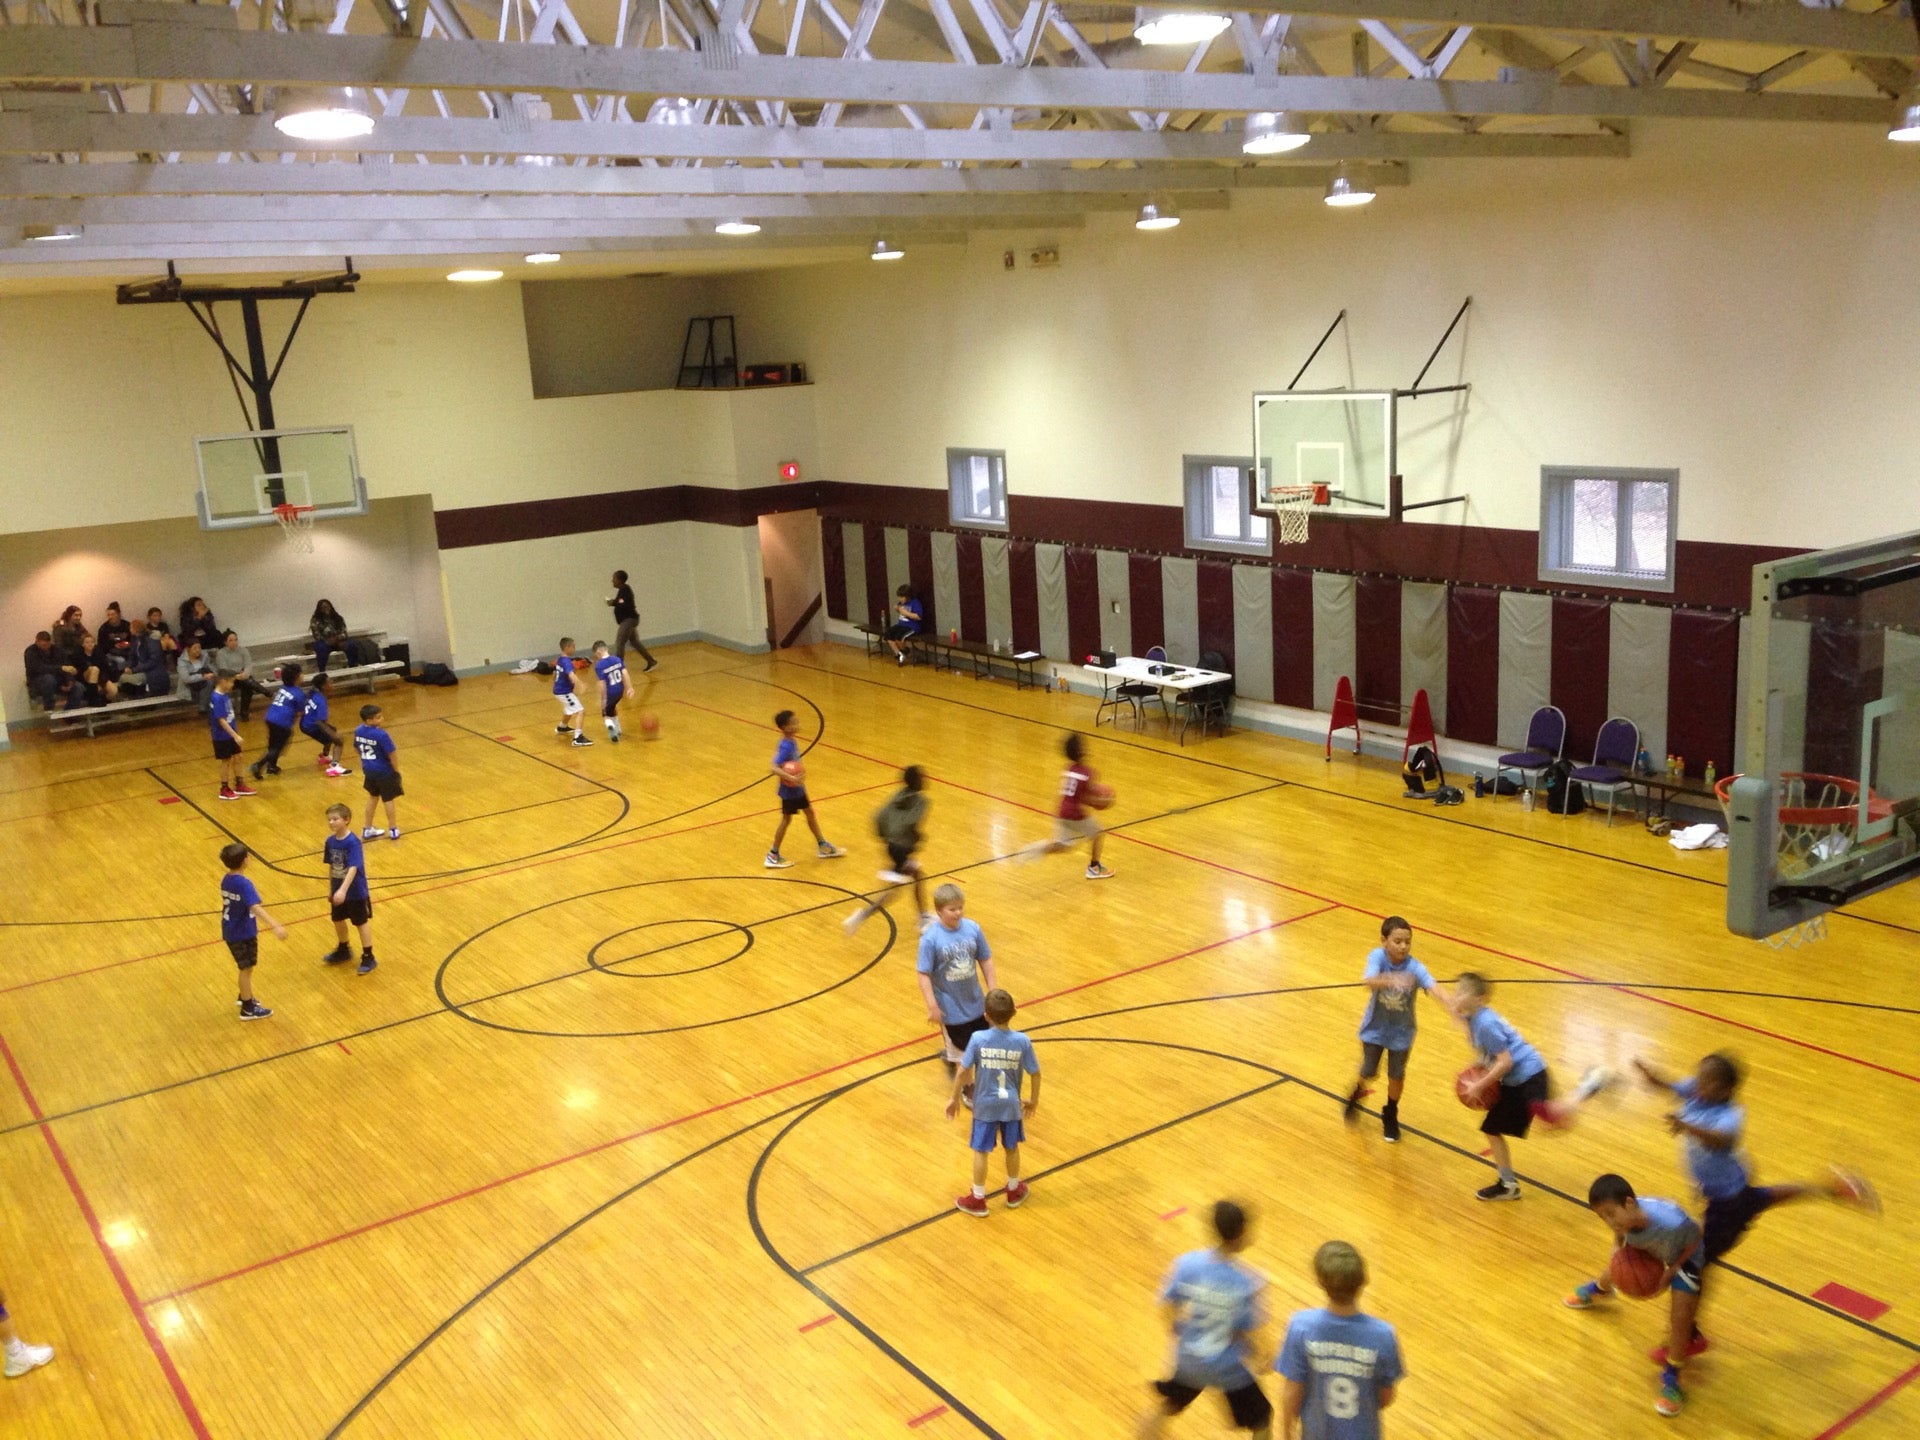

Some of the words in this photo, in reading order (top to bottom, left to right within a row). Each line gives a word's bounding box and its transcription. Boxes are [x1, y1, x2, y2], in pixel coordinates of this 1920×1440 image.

[608, 669, 622, 686] 10
[359, 743, 377, 760] 12
[981, 1047, 1007, 1060] SUPER
[997, 1069, 1009, 1099] 1
[1327, 1376, 1360, 1420] 8
